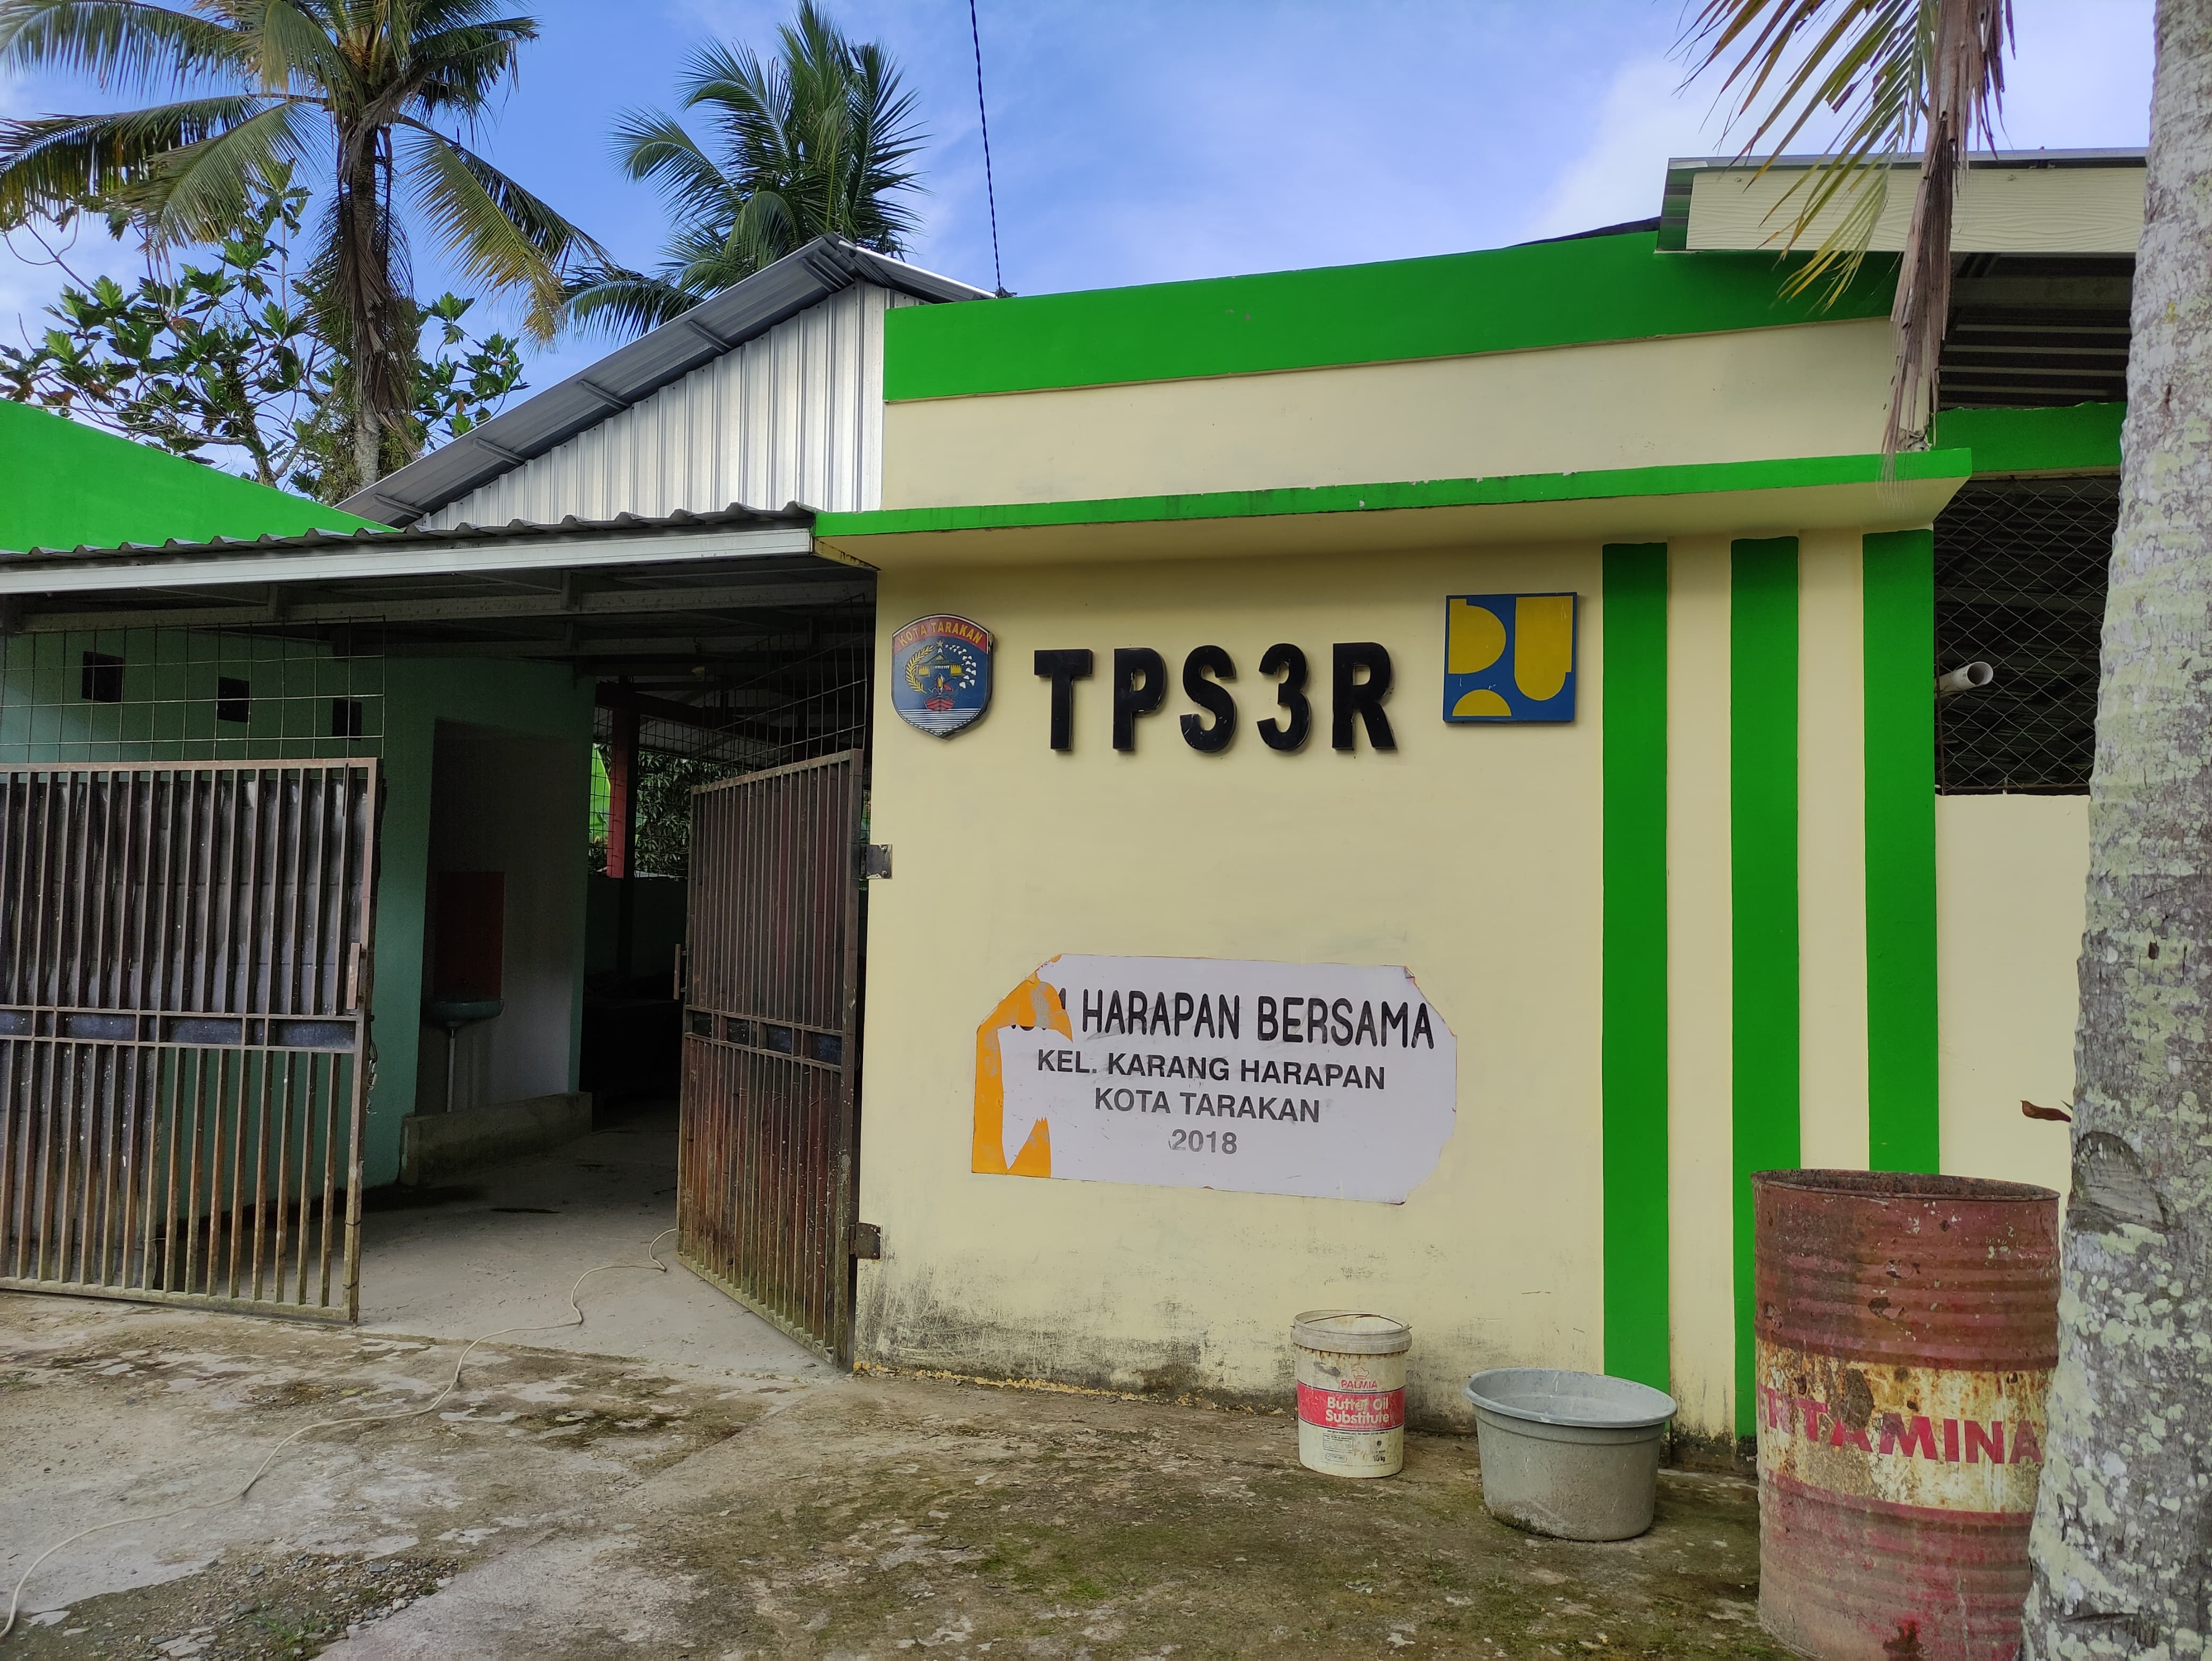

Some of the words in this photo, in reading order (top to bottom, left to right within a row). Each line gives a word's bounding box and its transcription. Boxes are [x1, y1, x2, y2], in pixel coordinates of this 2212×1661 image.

[898, 625, 927, 646] KOTA
[931, 621, 983, 644] TARAKAN
[1034, 641, 1397, 753] TPS3R
[1082, 988, 1241, 1040] HARAPAN
[1256, 996, 1434, 1050] BERSAMA
[1037, 1048, 1097, 1074] KEL.
[1108, 1053, 1229, 1081] KARANG
[1241, 1059, 1385, 1090] HARAPAN
[1094, 1087, 1171, 1114] KOTA
[1179, 1092, 1320, 1123] TARAKAN
[1170, 1129, 1237, 1155] 2018
[1341, 1380, 1378, 1389] PALMIA
[1326, 1409, 1389, 1424] Substitute
[1372, 1397, 1389, 1410] Oil
